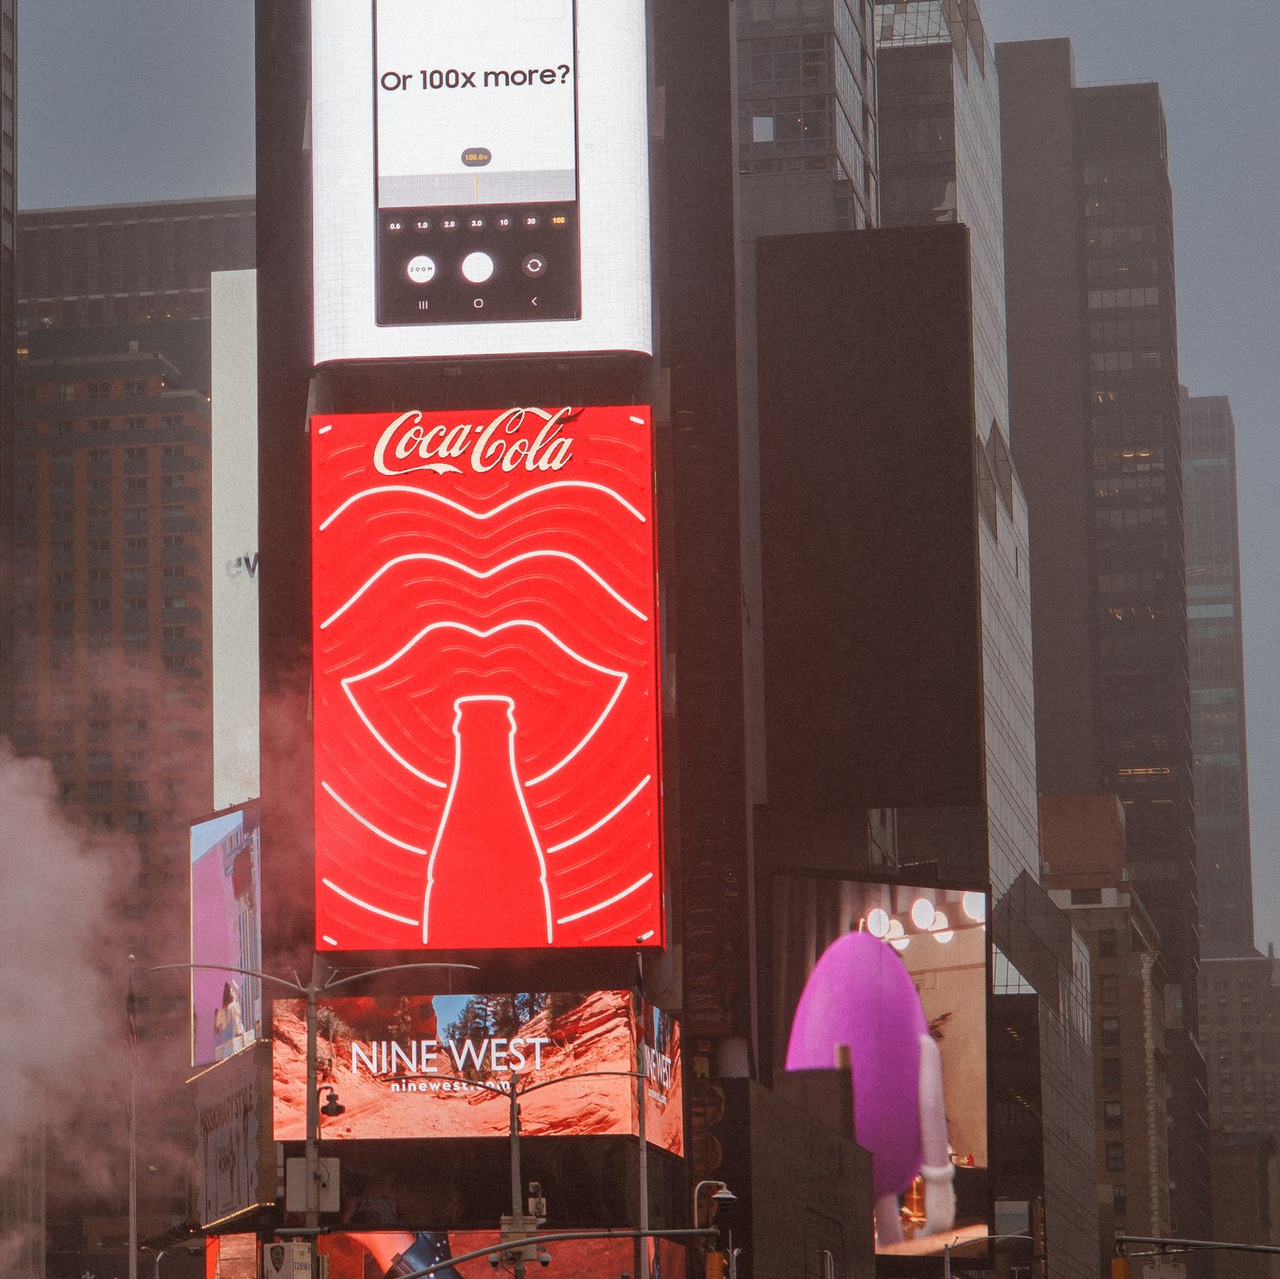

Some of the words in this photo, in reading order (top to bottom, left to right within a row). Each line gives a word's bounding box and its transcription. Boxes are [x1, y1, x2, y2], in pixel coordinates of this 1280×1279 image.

[381, 69, 413, 91] Or
[420, 68, 476, 90] 100x
[484, 64, 570, 87] more?
[374, 407, 573, 475] Coca-Cola
[351, 1040, 438, 1074] NINE
[449, 1037, 551, 1072] WEST
